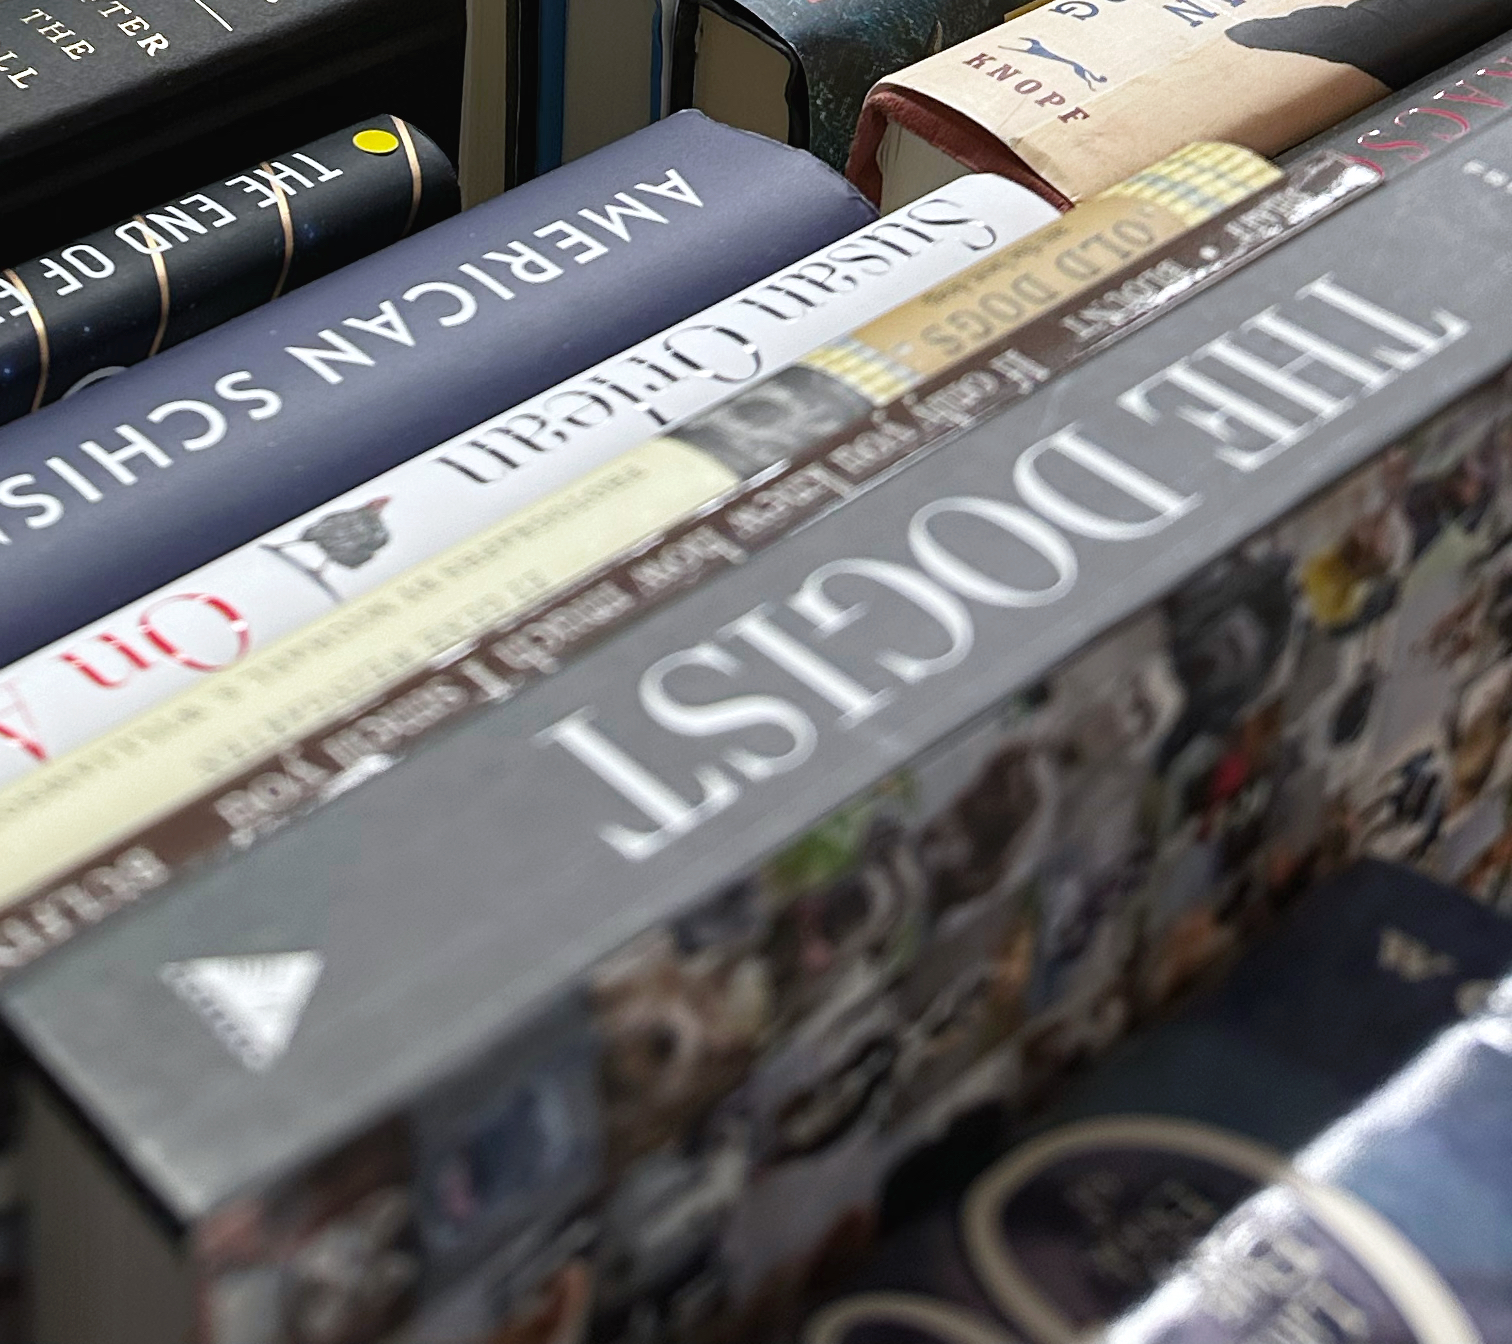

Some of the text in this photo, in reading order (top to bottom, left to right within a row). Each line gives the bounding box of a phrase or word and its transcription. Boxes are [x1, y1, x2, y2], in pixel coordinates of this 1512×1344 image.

[20, 7, 97, 66] THE
[960, 52, 1094, 126] KNOPF
[115, 191, 241, 259] END
[223, 148, 345, 214] THE
[38, 242, 118, 298] OF
[281, 165, 707, 390] AMERICAN
[434, 193, 1003, 490] Susan Orlean
[1117, 273, 1471, 475] THE
[60, 589, 255, 691] On
[534, 422, 1200, 859] DOGIST
